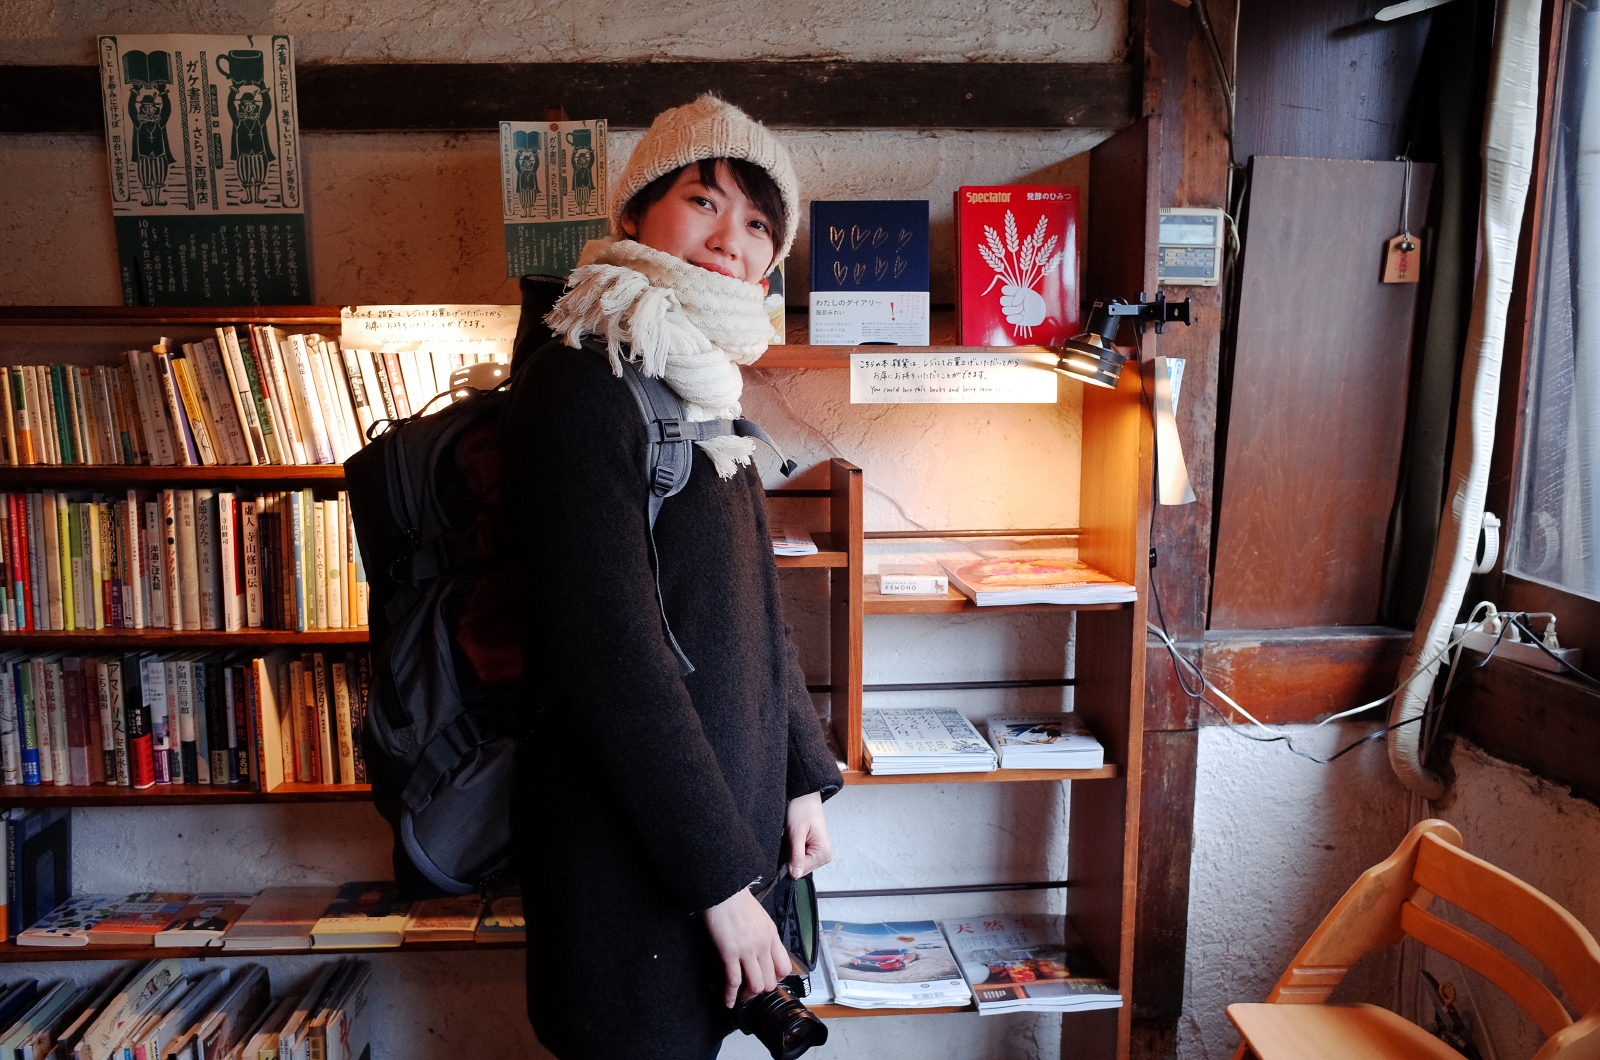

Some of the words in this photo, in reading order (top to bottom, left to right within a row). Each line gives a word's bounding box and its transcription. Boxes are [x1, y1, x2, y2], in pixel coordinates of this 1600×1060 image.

[186, 60, 208, 205] ガケ書房・さらさ西陣店
[965, 191, 1012, 204] Spectator
[1026, 191, 1072, 201] 発酵のひみつ
[815, 299, 883, 307] わたしのダイアリー
[870, 385, 881, 394] You
[948, 385, 960, 393] and
[183, 496, 192, 527] 最後の晩餐
[198, 496, 210, 546] 季節のかたみ
[244, 504, 255, 527] 虚人
[221, 517, 229, 545] 寺山修司
[150, 543, 162, 591] 洋酒こぼれ話
[246, 531, 257, 588] 寺山修司伝
[108, 662, 125, 734] アマリリス
[316, 670, 326, 715] ピンク・フロイド
[115, 737, 127, 780] 安西水丸
